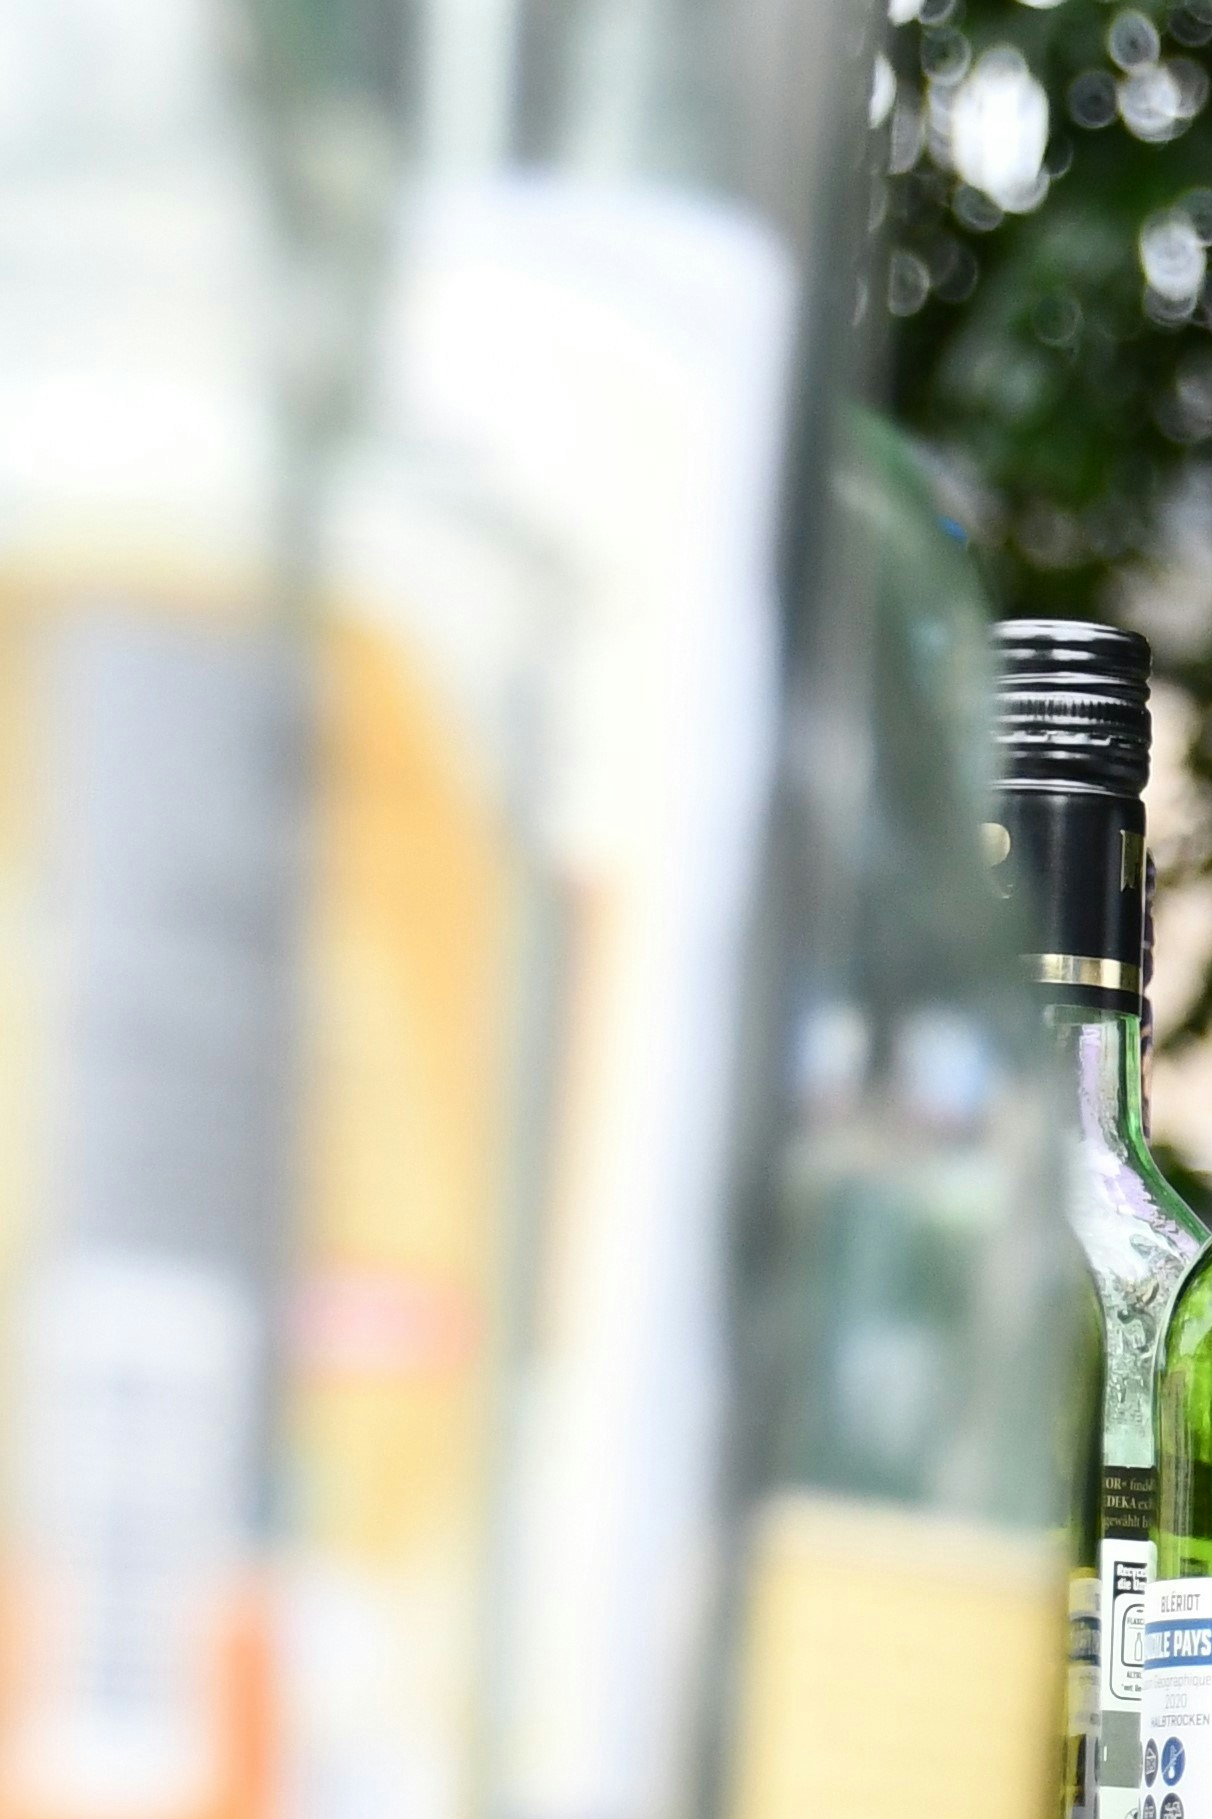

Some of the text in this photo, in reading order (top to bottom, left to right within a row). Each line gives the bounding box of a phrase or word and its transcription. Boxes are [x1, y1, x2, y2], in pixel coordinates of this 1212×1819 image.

[1161, 1591, 1200, 1614] BLÉRIOT
[1174, 1628, 1211, 1658] PAYS
[1165, 1693, 1187, 1710] 2020
[1151, 1713, 1211, 1728] HALBTROCKEN
